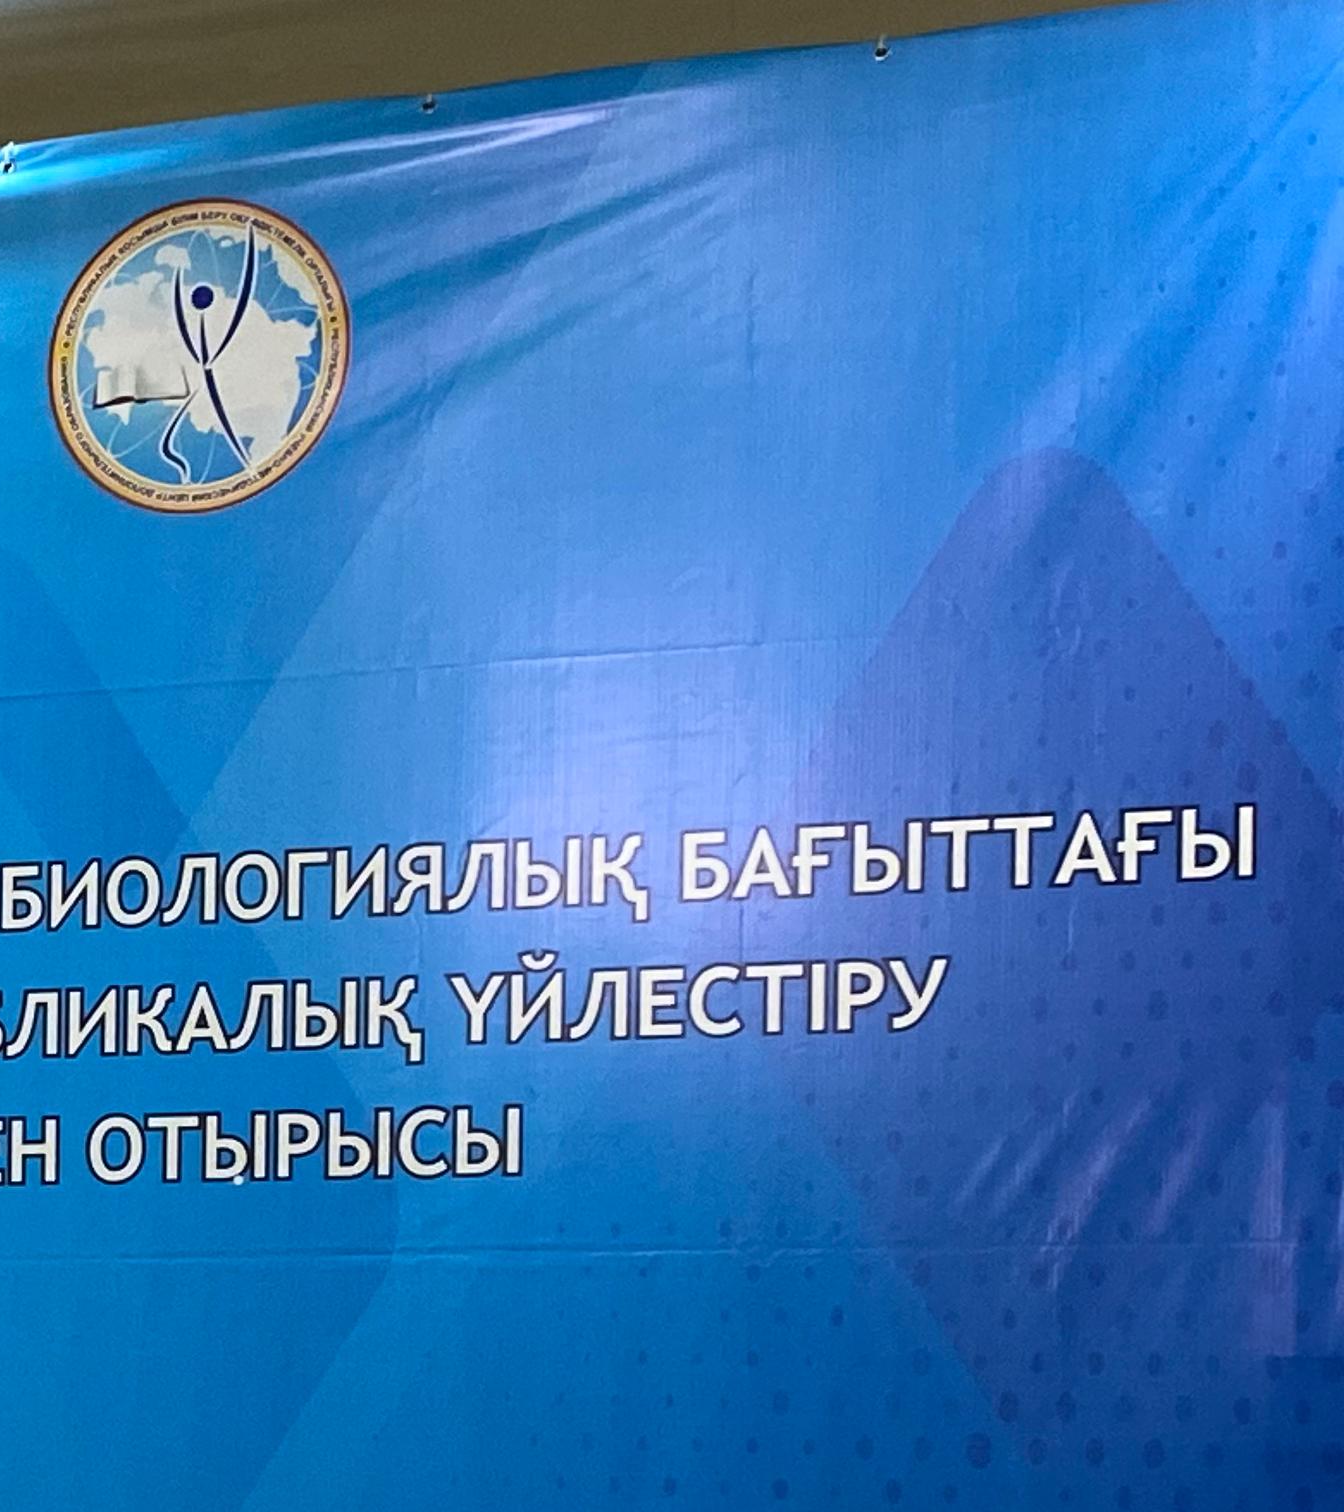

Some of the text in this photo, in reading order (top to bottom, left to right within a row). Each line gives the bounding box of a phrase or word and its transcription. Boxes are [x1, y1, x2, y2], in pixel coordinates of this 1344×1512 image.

[680, 803, 1256, 902] БАҒЫТТАҒЫ
[449, 951, 949, 1044] ҮЙЛЕСТІРУ
[87, 1106, 522, 1184] ОТЫРЫСЫ
